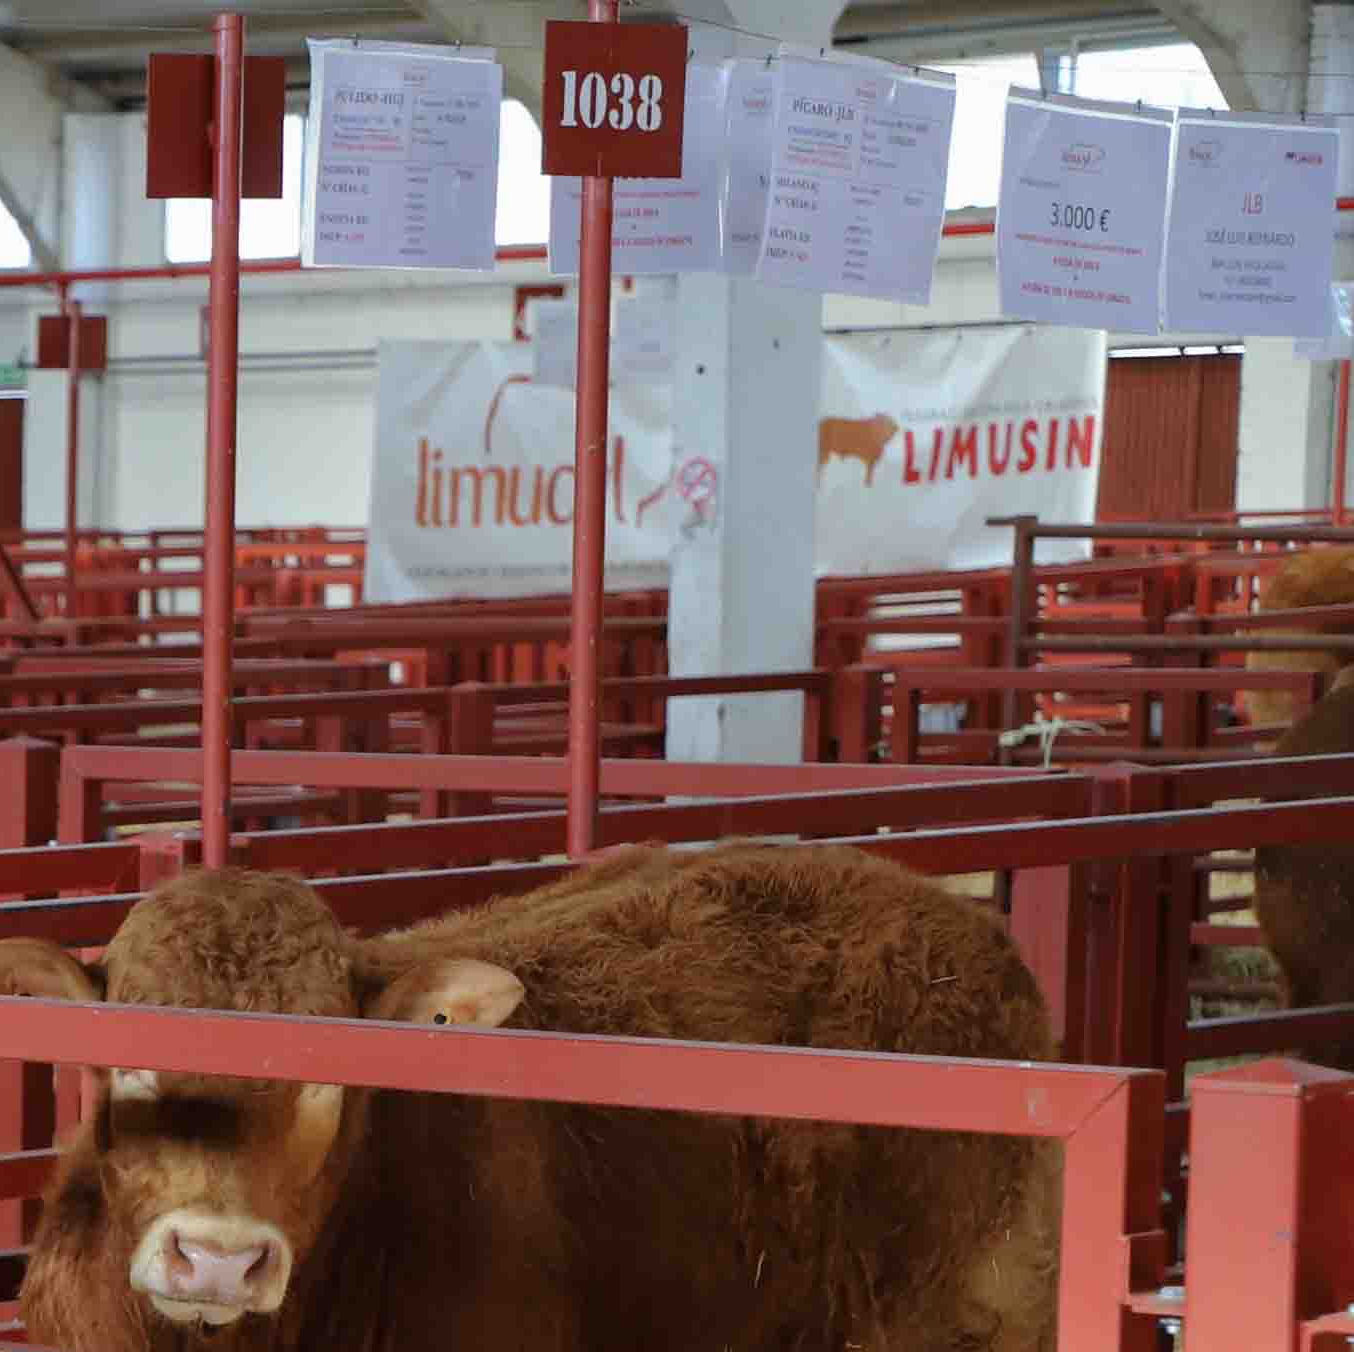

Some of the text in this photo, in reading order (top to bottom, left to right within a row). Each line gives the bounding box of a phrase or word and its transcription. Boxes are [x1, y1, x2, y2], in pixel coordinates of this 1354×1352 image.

[560, 70, 662, 131] 1038
[1051, 202, 1111, 232] 3.000 €
[415, 437, 629, 529] limucl
[903, 416, 1096, 485] LIMUSIN
